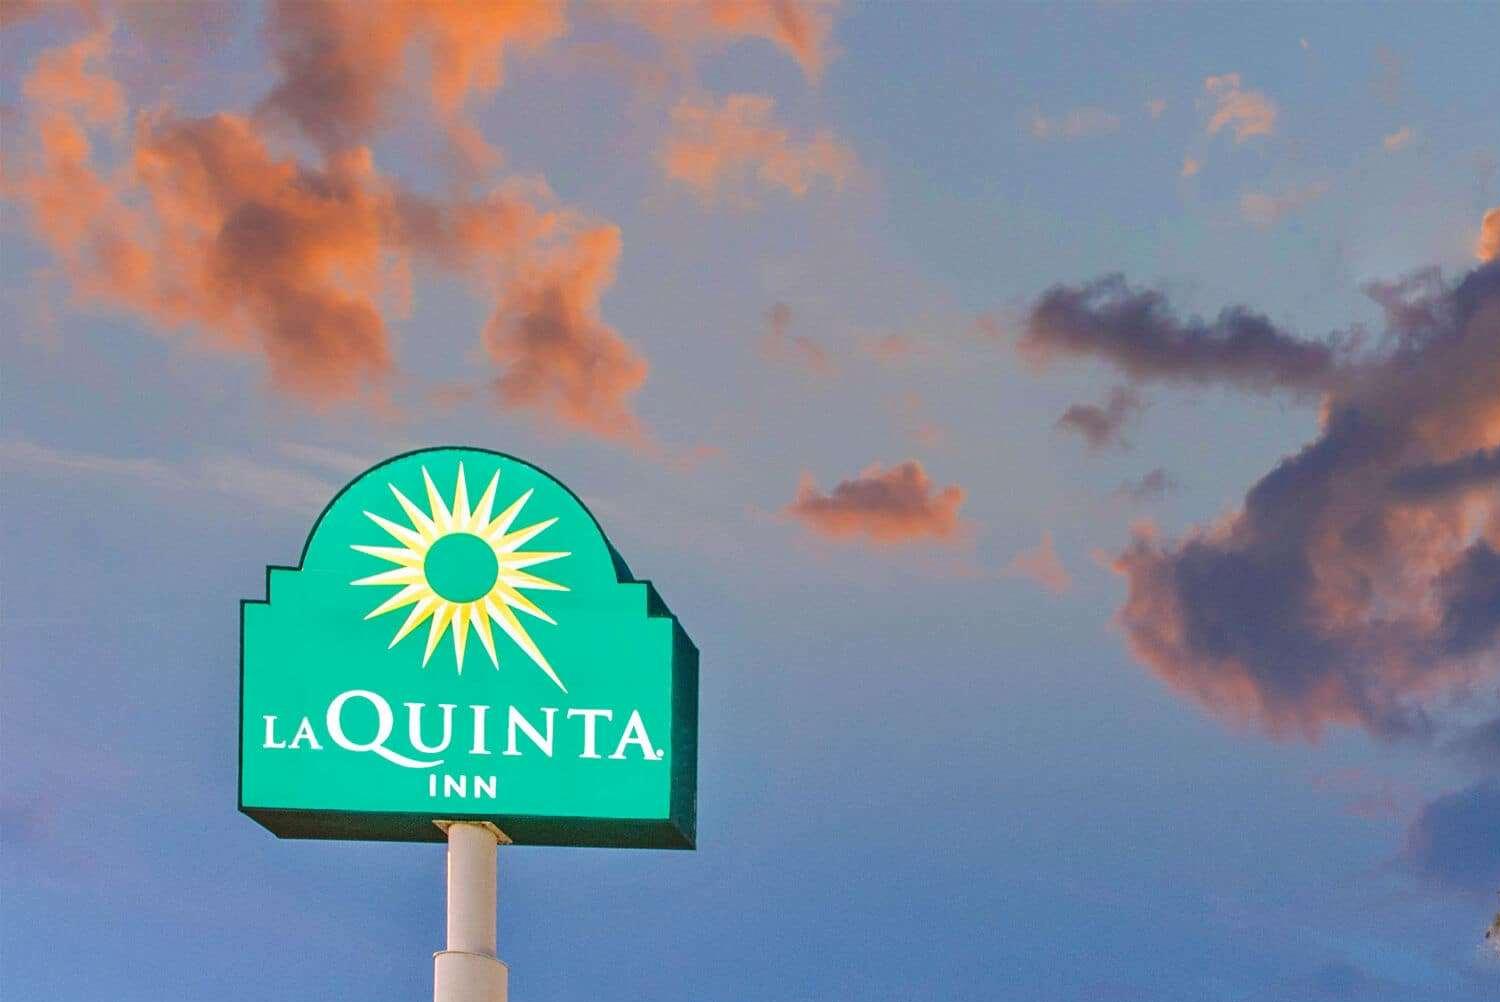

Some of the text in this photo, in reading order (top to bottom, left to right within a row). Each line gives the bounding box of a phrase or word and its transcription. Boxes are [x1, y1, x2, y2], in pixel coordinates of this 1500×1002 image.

[263, 689, 664, 769] LA QUINTA
[429, 774, 497, 799] INN
